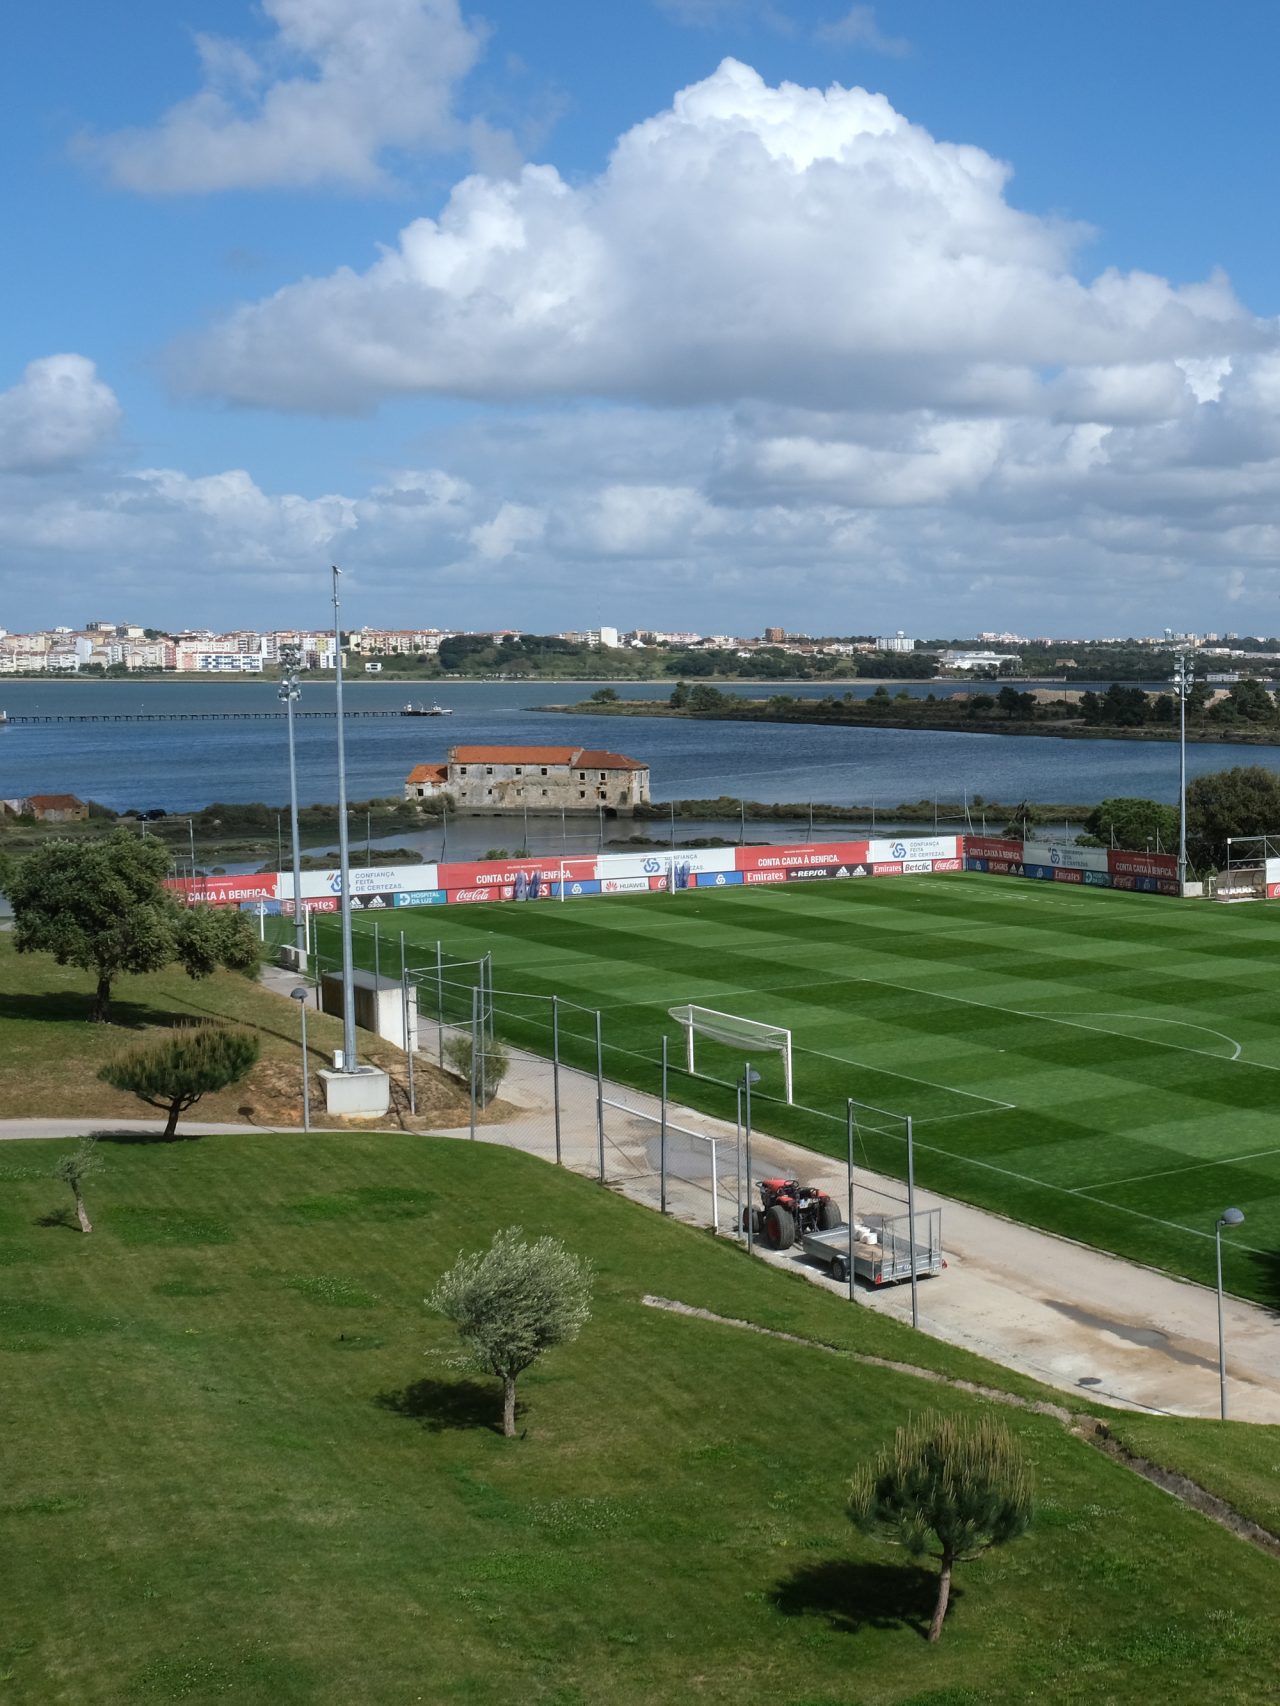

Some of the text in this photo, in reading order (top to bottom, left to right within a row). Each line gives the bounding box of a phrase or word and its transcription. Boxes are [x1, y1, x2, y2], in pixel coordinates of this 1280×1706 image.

[970, 848, 983, 856] CONTA
[984, 849, 998, 857] CAIXA
[758, 857, 780, 867] CONTA
[781, 856, 803, 865] CAIXA
[803, 854, 810, 864] À
[874, 864, 902, 873] Emirates
[904, 862, 930, 872] Betclic
[1115, 863, 1132, 872] CONTA
[1132, 863, 1147, 873] CAIXA
[355, 871, 395, 879] CONFIANÇA
[476, 873, 503, 884] CONTA
[747, 871, 784, 882] Emirates
[797, 869, 828, 878] REPSOL
[1055, 868, 1080, 881] Emirates
[188, 891, 217, 902] CAIXA
[219, 889, 226, 900] À
[411, 891, 440, 899] HOSPITAL
